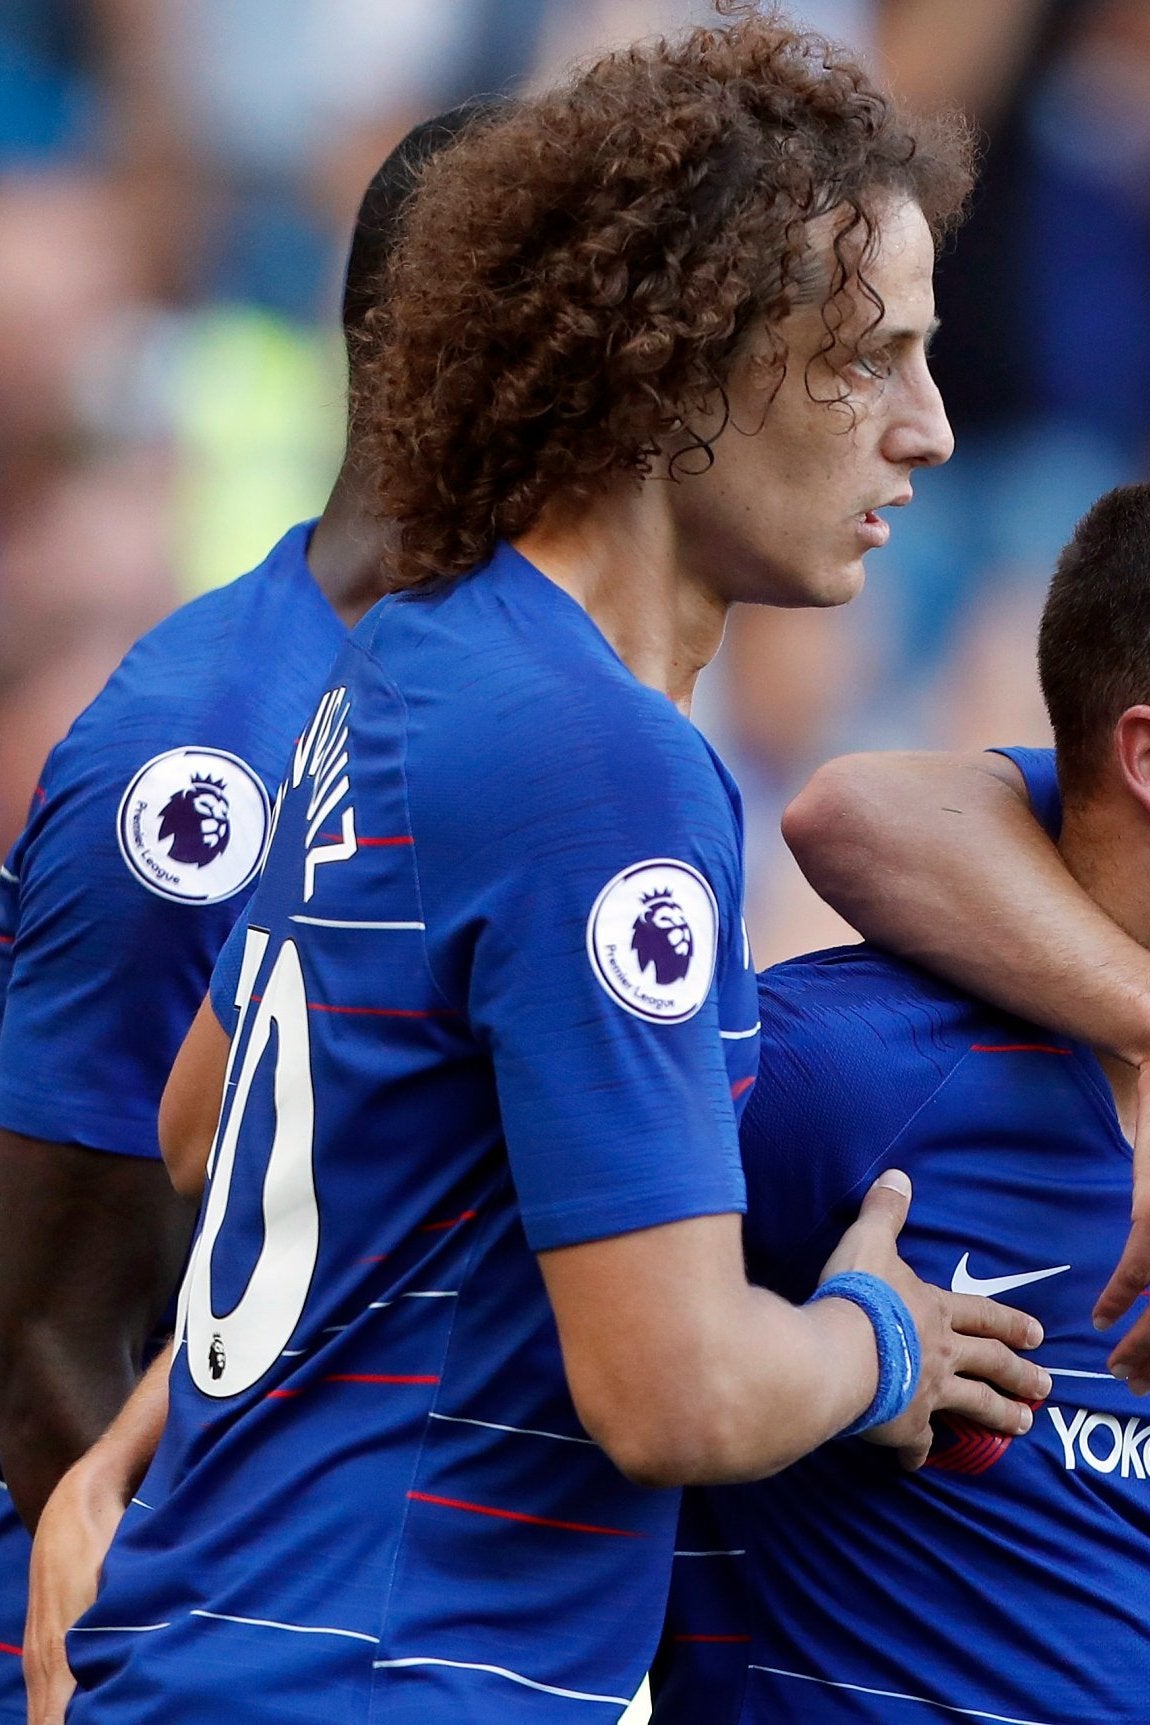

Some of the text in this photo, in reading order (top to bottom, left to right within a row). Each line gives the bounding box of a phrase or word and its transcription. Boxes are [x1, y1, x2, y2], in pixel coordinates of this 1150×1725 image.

[133, 800, 181, 885] Premier League
[605, 943, 675, 1010] Premier League
